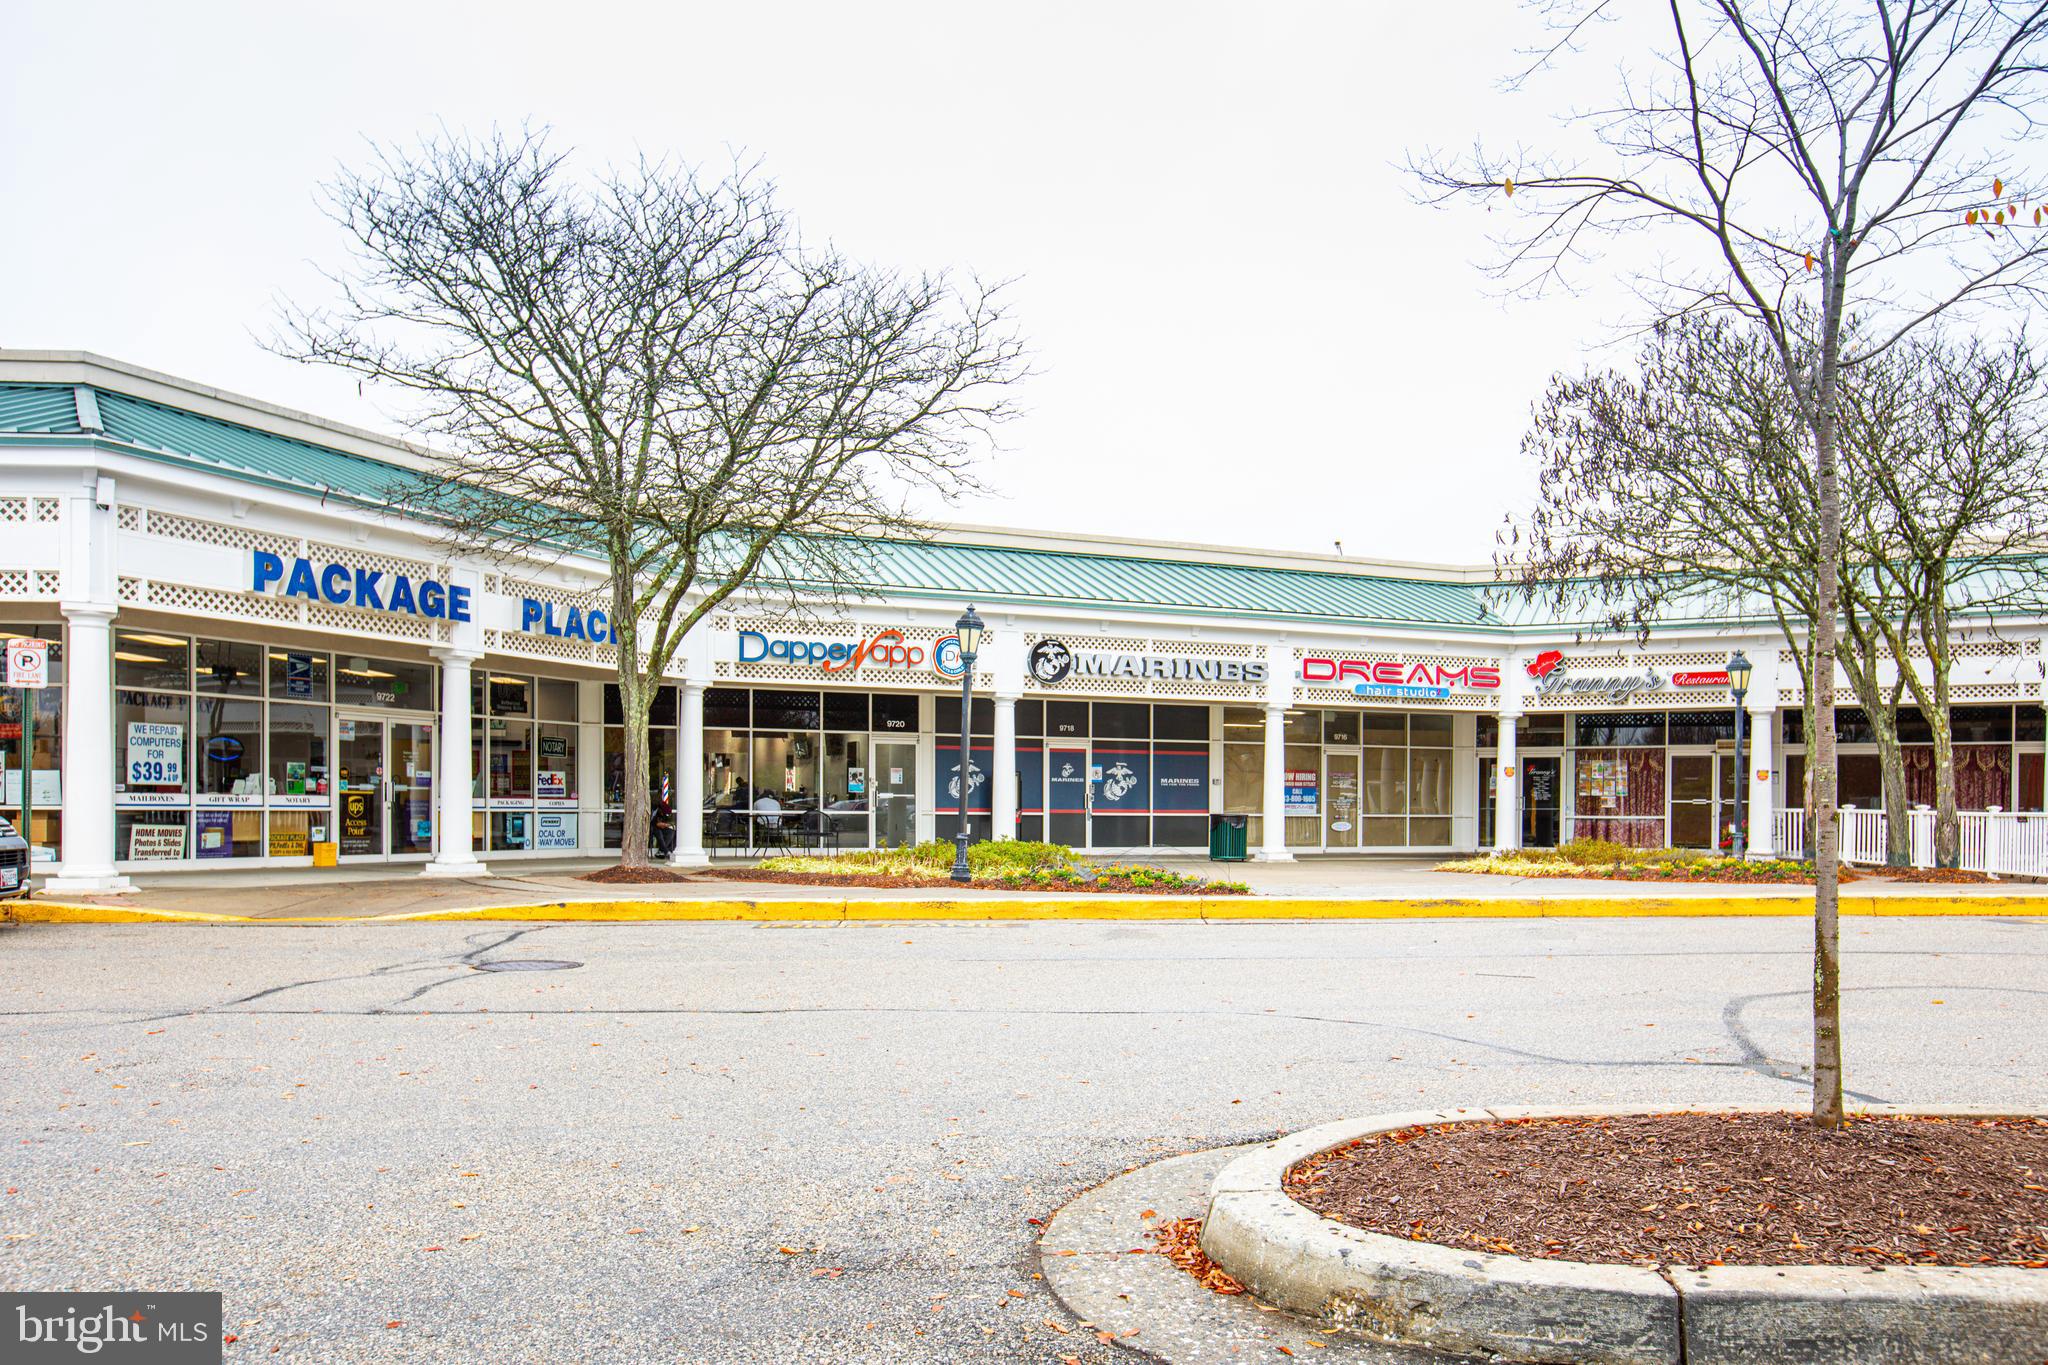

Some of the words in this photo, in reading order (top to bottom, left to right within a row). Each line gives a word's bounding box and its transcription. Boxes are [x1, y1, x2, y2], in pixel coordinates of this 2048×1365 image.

[253, 550, 471, 622] PACKAGE
[22, 655, 34, 666] P
[1075, 653, 1270, 682] MARINES
[1303, 658, 1501, 688] DREAMS
[1536, 666, 1666, 702] Granny's
[1675, 673, 1731, 685] Restauran
[1366, 686, 1391, 696] hair
[376, 692, 395, 702] 9722
[886, 720, 905, 728] 9720
[1059, 724, 1074, 732] 9718
[134, 724, 148, 734] WE
[149, 725, 178, 736] REPAIR
[130, 736, 181, 748] COMPUTERS
[543, 741, 565, 752] NOTARY
[147, 749, 164, 759] FOR
[538, 773, 563, 786] FedEx
[1296, 773, 1316, 781] HIRING
[350, 801, 364, 815] ups
[346, 819, 367, 827] Access
[135, 828, 156, 837] HOME
[157, 828, 183, 838] MOVIES
[348, 827, 365, 836] Point
[538, 830, 555, 838] OCAL
[556, 830, 566, 838] OR
[134, 838, 157, 847] Photos
[163, 838, 182, 847] Slides
[554, 838, 576, 847] MOVES
[134, 848, 173, 857] Transferred
[173, 848, 181, 857] to
